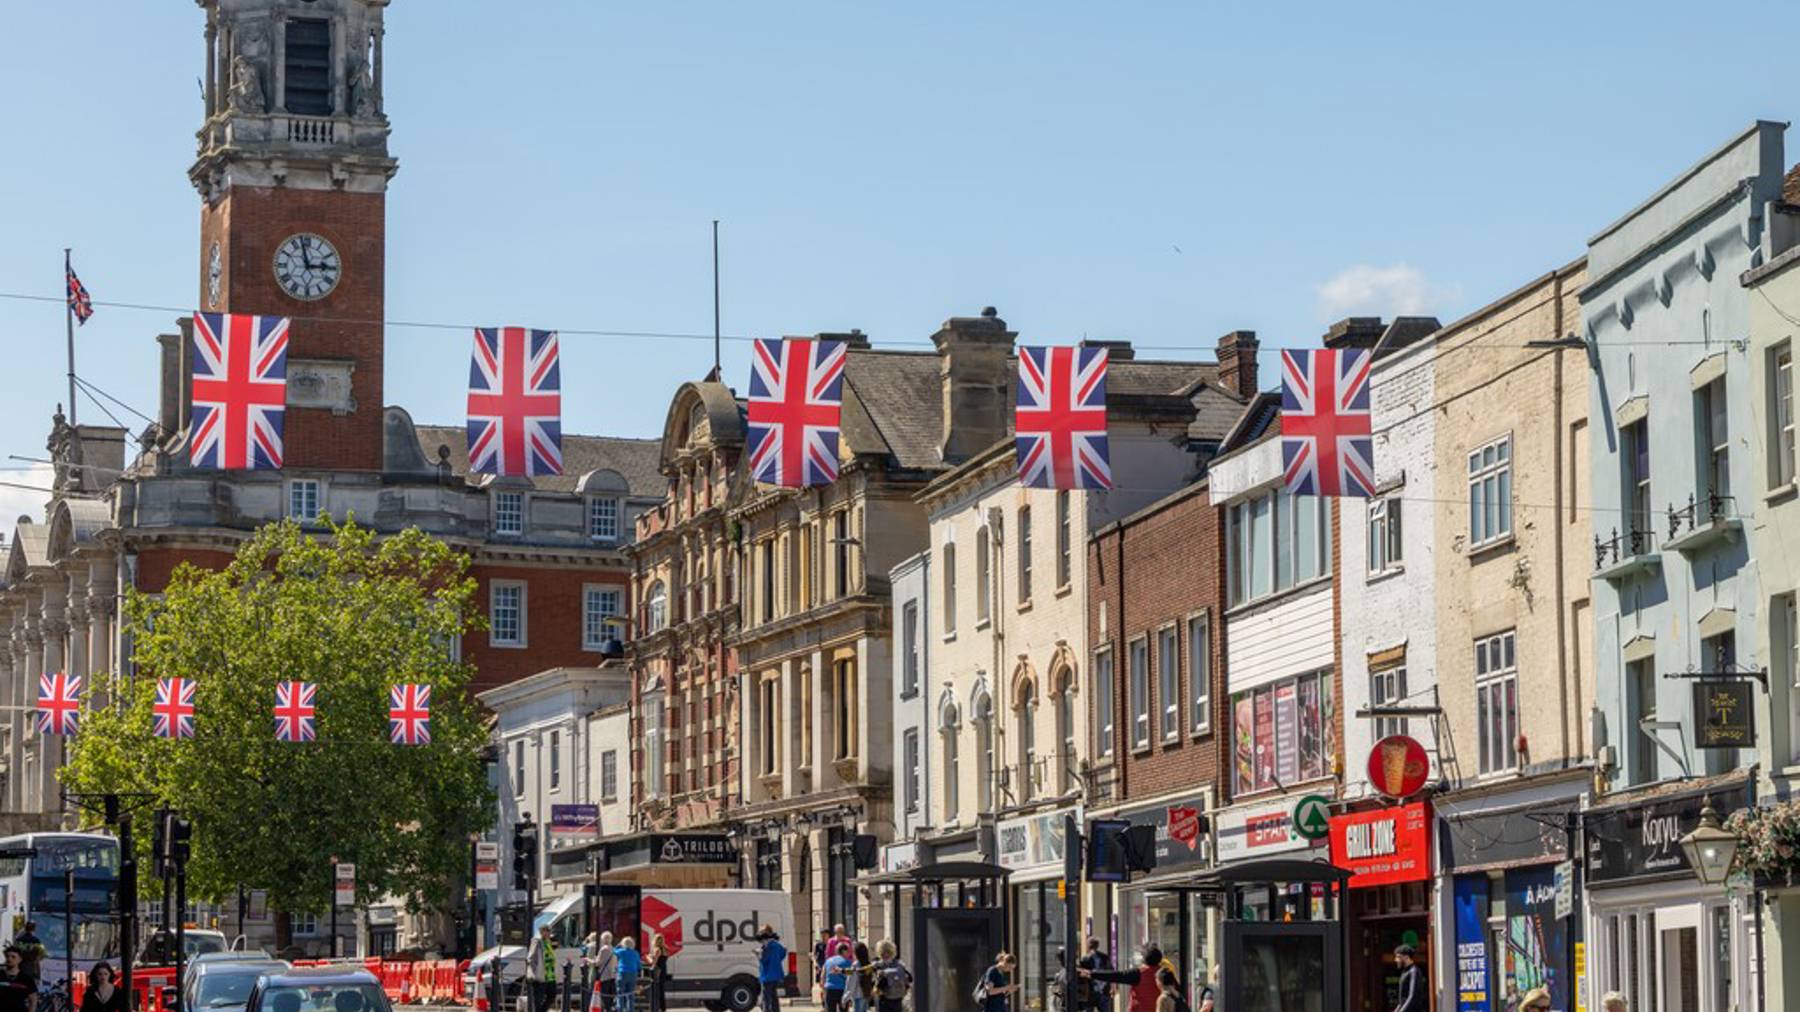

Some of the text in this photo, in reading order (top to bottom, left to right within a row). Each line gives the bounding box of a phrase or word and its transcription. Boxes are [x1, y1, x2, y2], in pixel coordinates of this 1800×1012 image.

[683, 840, 731, 852] TRILOGY
[1255, 816, 1288, 841] SPAR
[1346, 824, 1372, 860] GRILL
[1372, 819, 1396, 855] ZONE
[1642, 810, 1678, 854] Koryu
[694, 909, 759, 951] dpd
